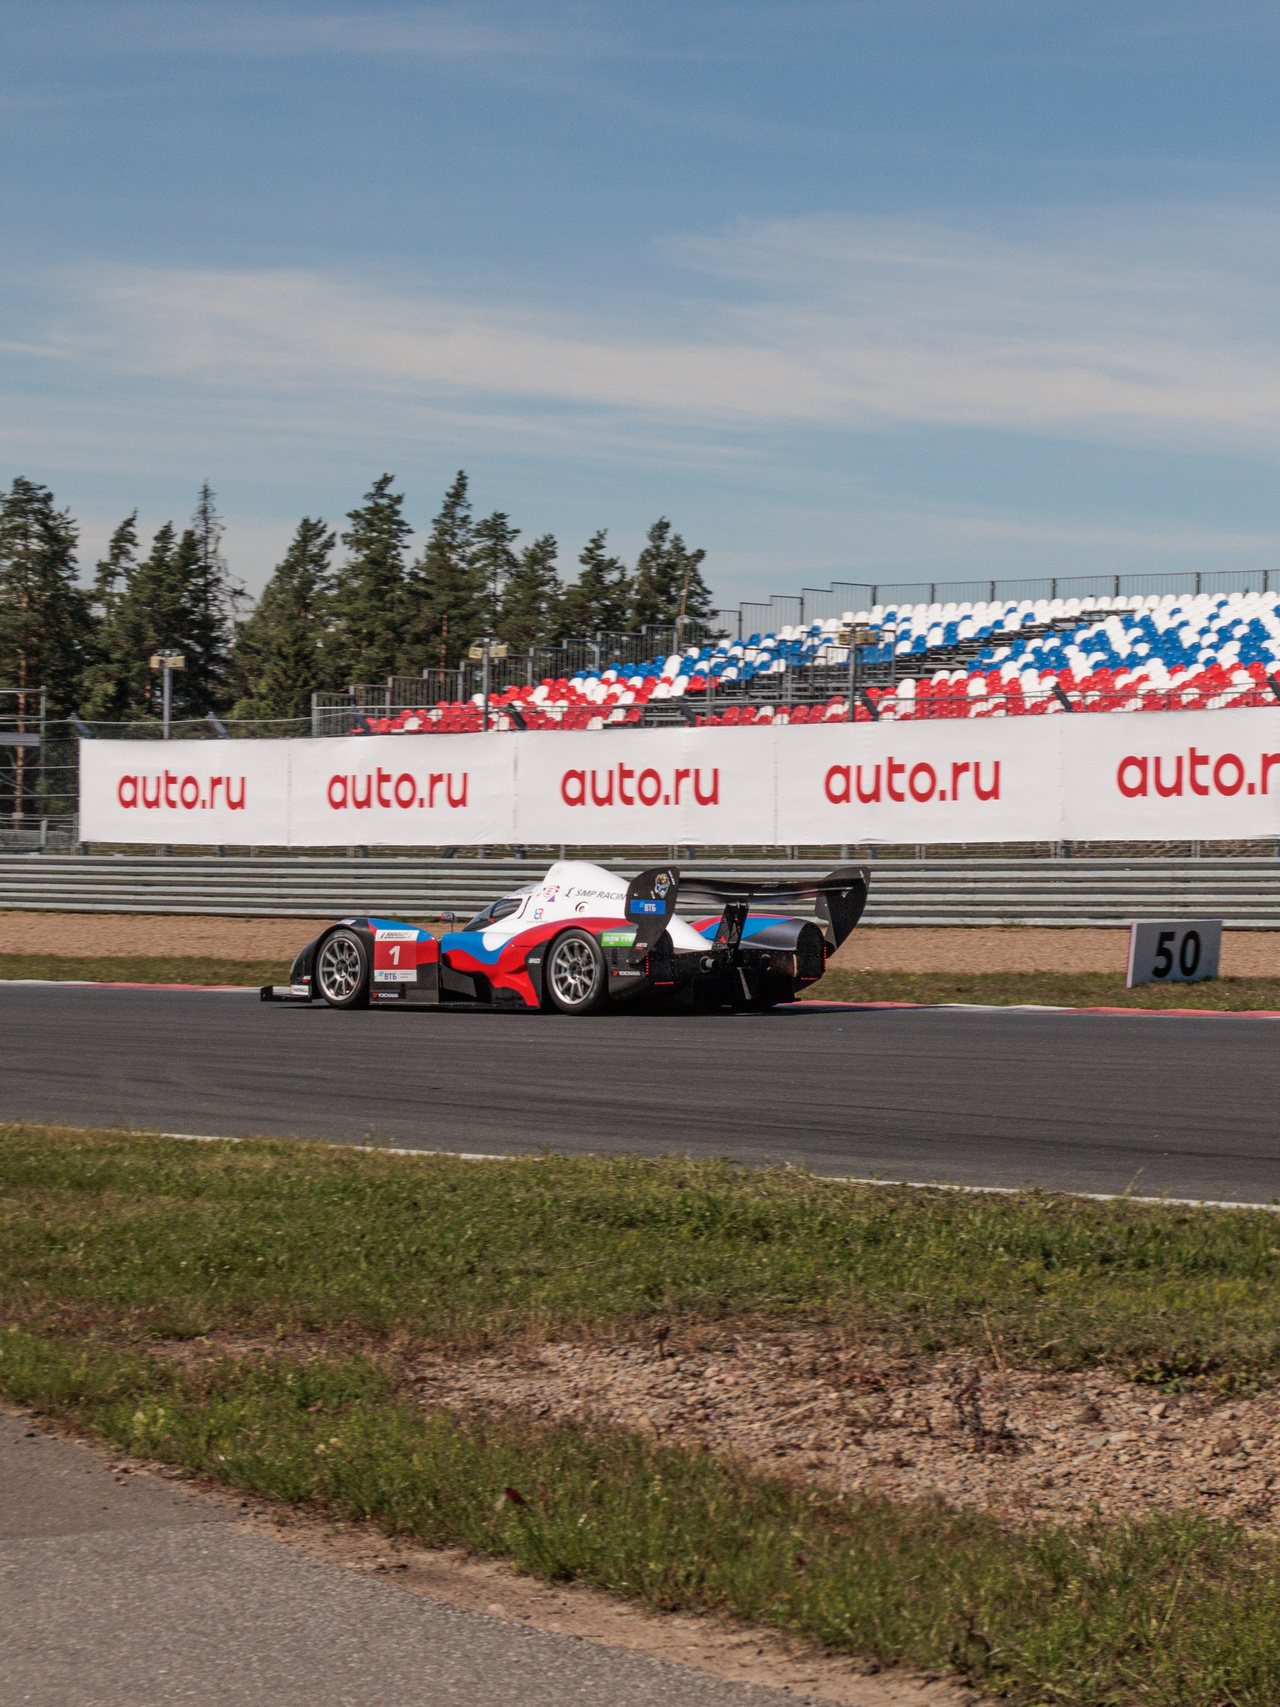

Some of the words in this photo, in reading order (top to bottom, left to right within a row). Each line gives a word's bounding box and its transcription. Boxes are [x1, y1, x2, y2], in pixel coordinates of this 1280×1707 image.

[118, 771, 247, 811] auto.ru
[328, 768, 469, 811] auto.ru
[561, 763, 720, 808] auto.ru
[825, 757, 1001, 805] auto.ru
[575, 889, 597, 897] SMP
[596, 891, 627, 901] RACIN
[388, 945, 401, 966] 1
[1151, 930, 1201, 979] 50
[384, 972, 397, 981] ВТБ
